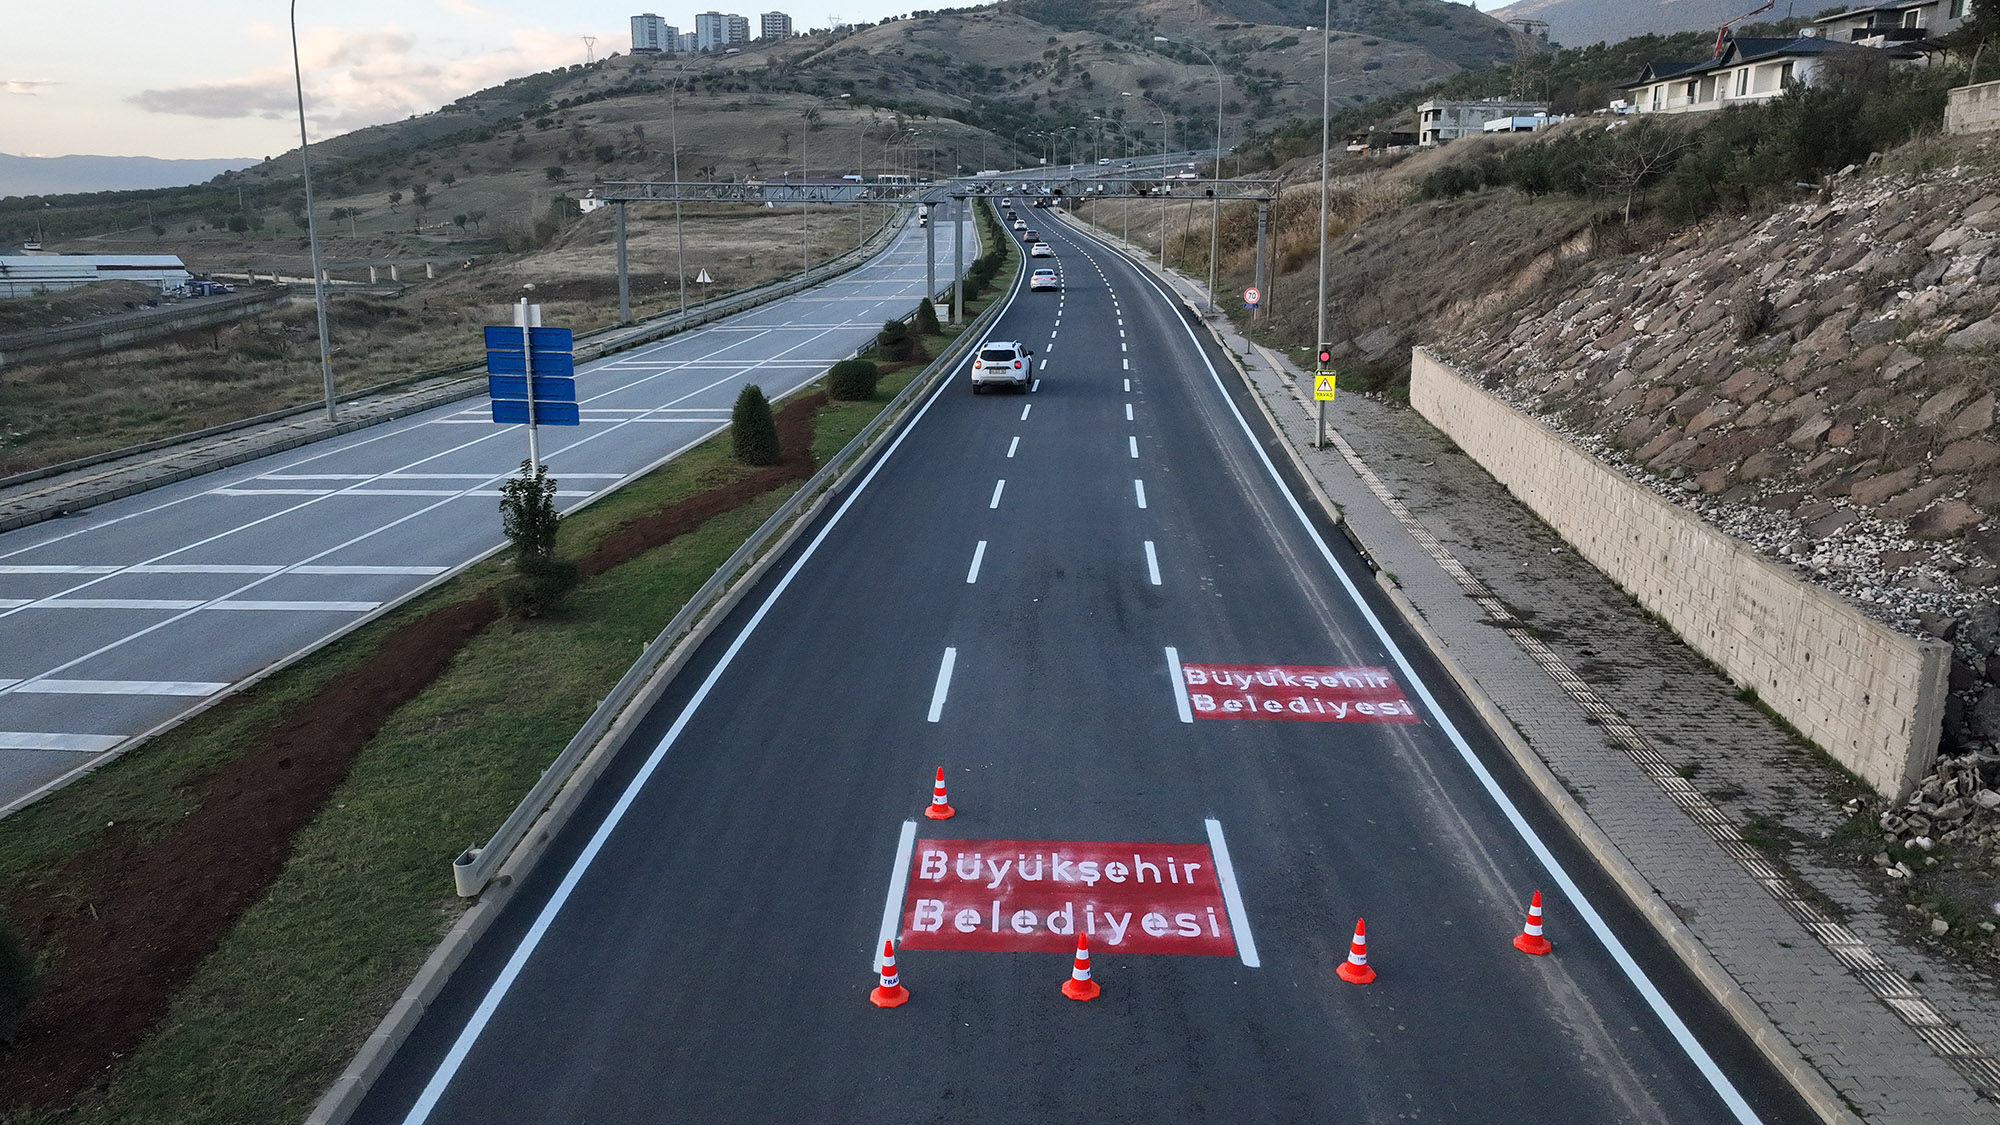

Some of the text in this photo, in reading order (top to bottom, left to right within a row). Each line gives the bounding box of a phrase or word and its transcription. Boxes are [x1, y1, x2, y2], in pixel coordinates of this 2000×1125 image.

[1248, 292, 1257, 300] 70
[1183, 668, 1390, 690] Büyükşehir
[1191, 694, 1414, 719] Belediyesi
[919, 850, 1202, 889] Büyükşehir
[912, 898, 1220, 946] Belediyesi
